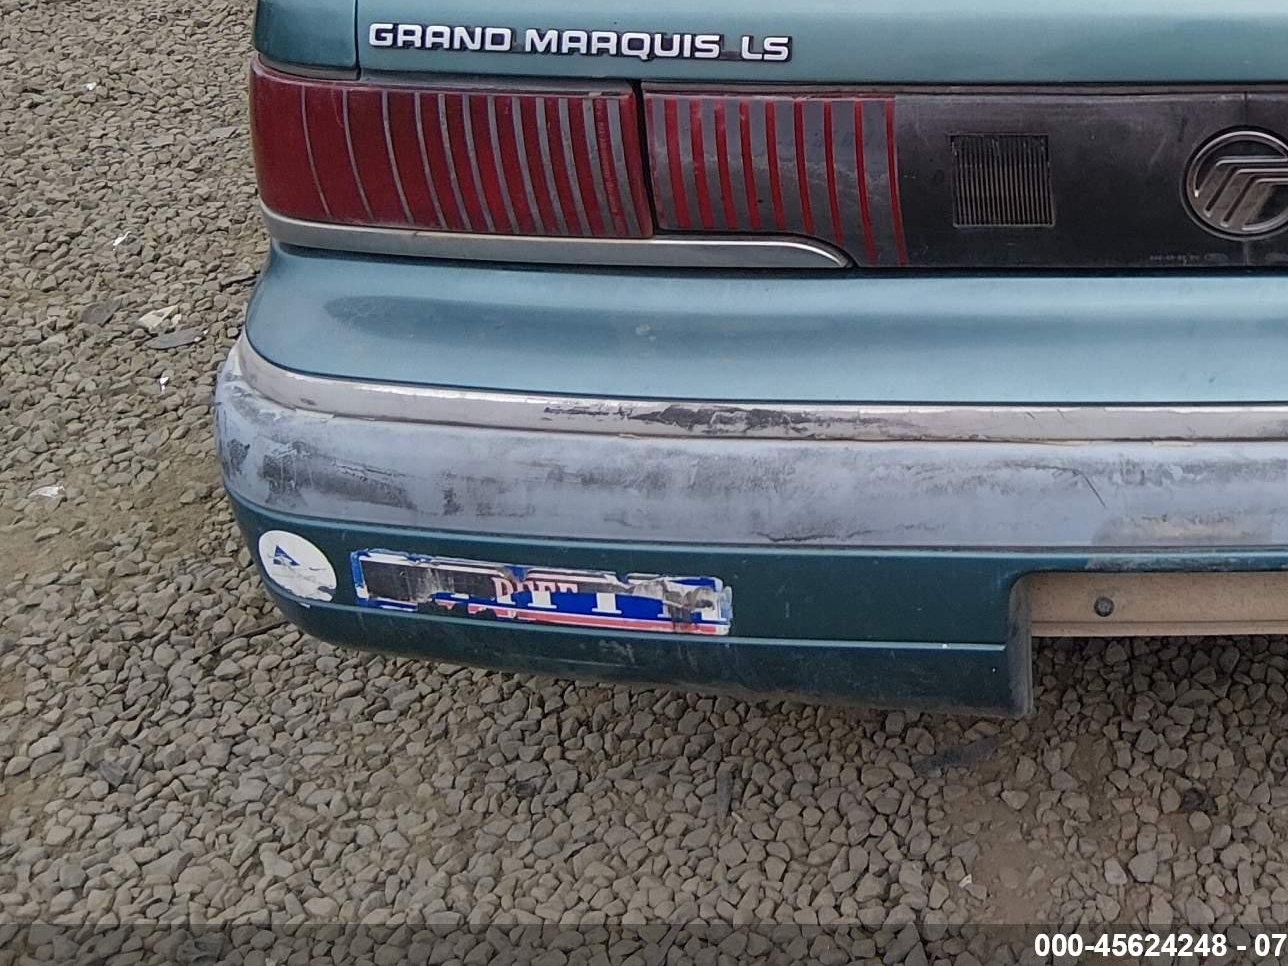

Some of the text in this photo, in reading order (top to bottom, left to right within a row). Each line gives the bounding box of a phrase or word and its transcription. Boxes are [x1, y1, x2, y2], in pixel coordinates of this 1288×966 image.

[368, 22, 790, 62] GRAND MARQUIS LS
